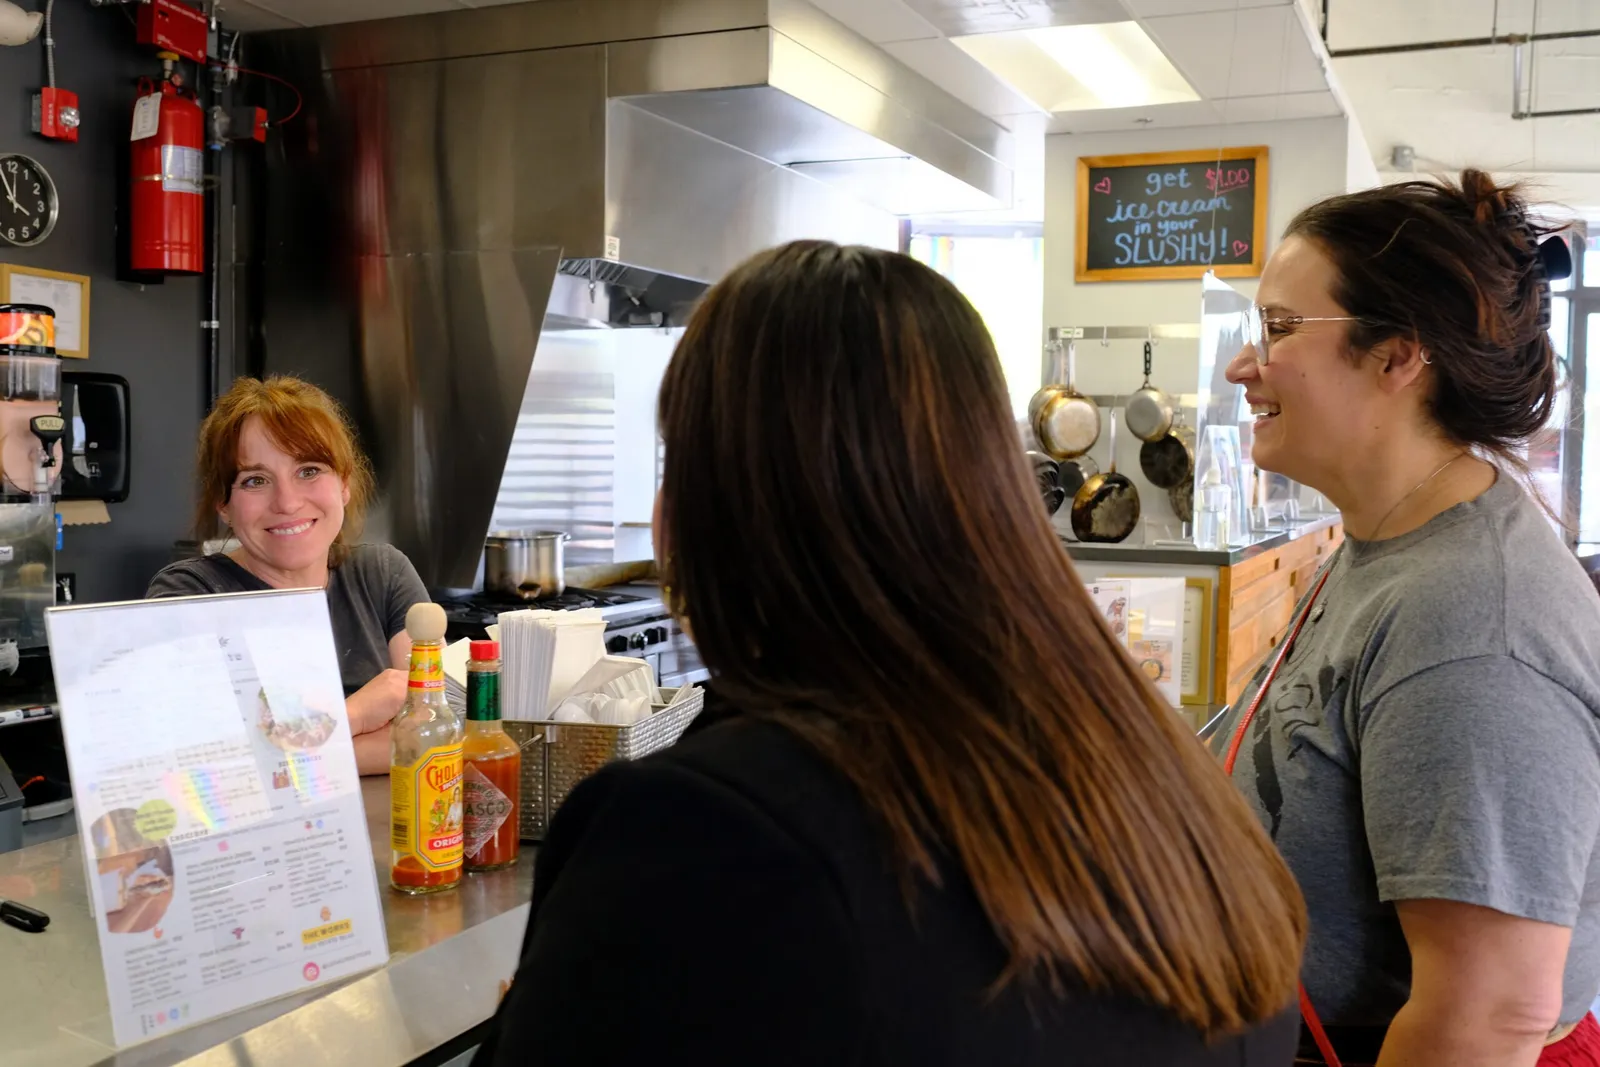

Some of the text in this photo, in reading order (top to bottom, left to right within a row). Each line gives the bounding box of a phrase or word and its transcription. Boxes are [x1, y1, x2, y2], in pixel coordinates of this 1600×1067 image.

[6, 161, 18, 174] 12
[23, 169, 29, 180] 1
[1145, 168, 1250, 195] get $1.00
[33, 183, 41, 195] 2
[37, 201, 45, 213] 3
[1106, 196, 1232, 223] ice cream
[32, 218, 40, 229] 4
[1134, 218, 1199, 237] in your
[7, 228, 16, 240] 6
[21, 226, 29, 238] 5
[1114, 227, 1228, 264] SLUSHY!
[40, 419, 60, 428] PULL
[463, 800, 506, 816] ASCO
